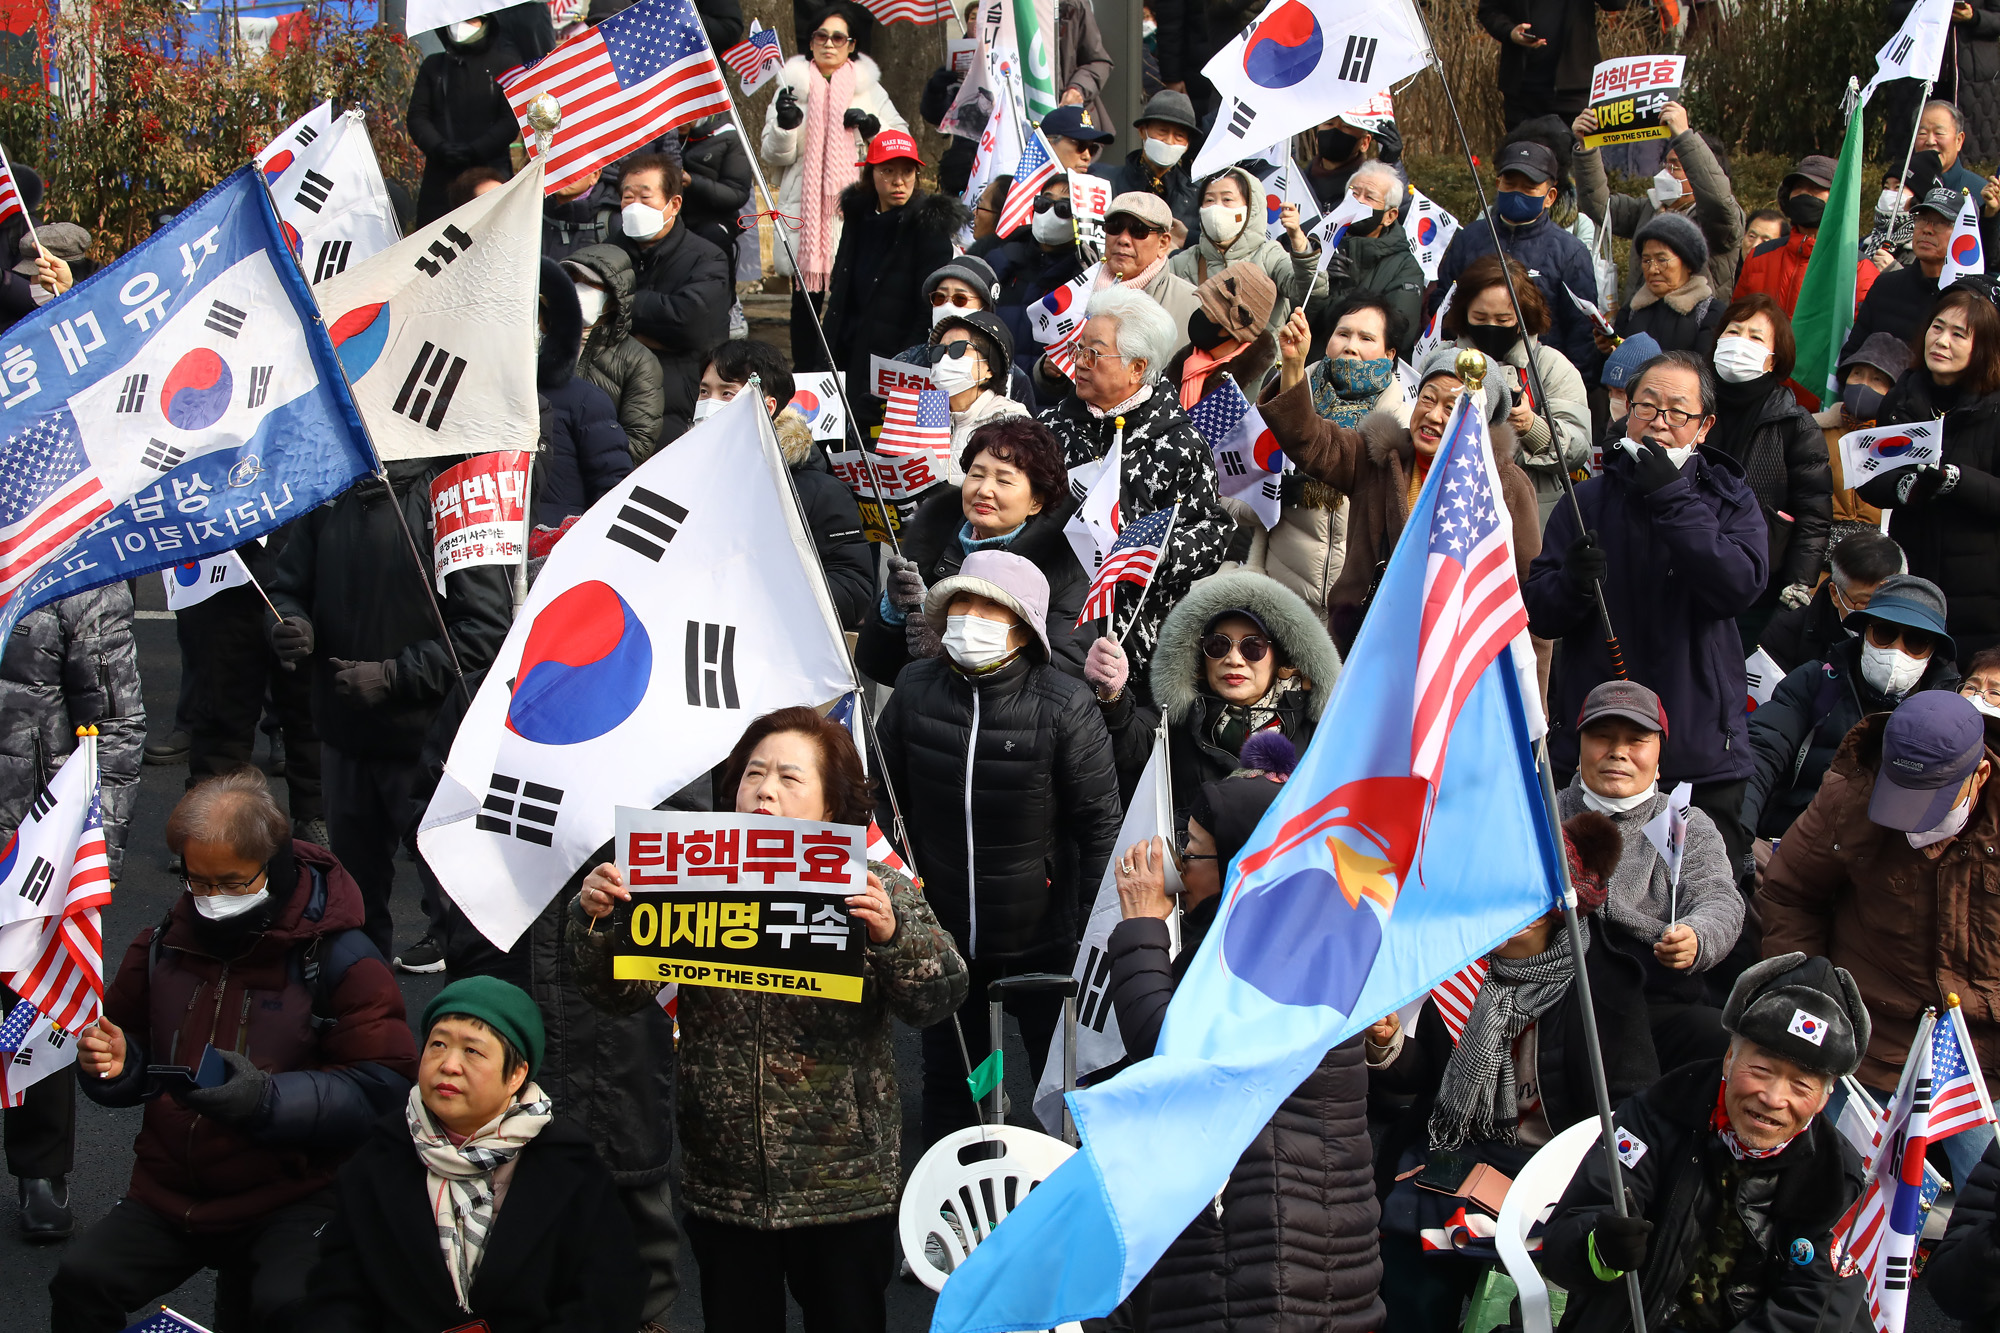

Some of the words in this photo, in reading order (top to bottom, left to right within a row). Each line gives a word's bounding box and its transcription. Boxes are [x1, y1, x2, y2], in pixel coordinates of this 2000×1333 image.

[1592, 59, 1677, 100] 탄핵무효
[1603, 135, 1620, 143] STOP
[1637, 129, 1662, 138] STEAL
[629, 829, 852, 885] 탄핵무효
[630, 901, 760, 949] 이재명
[765, 902, 850, 951] 구속
[658, 963, 711, 981] STOP
[714, 968, 753, 985] THE
[756, 973, 822, 992] STEAL
